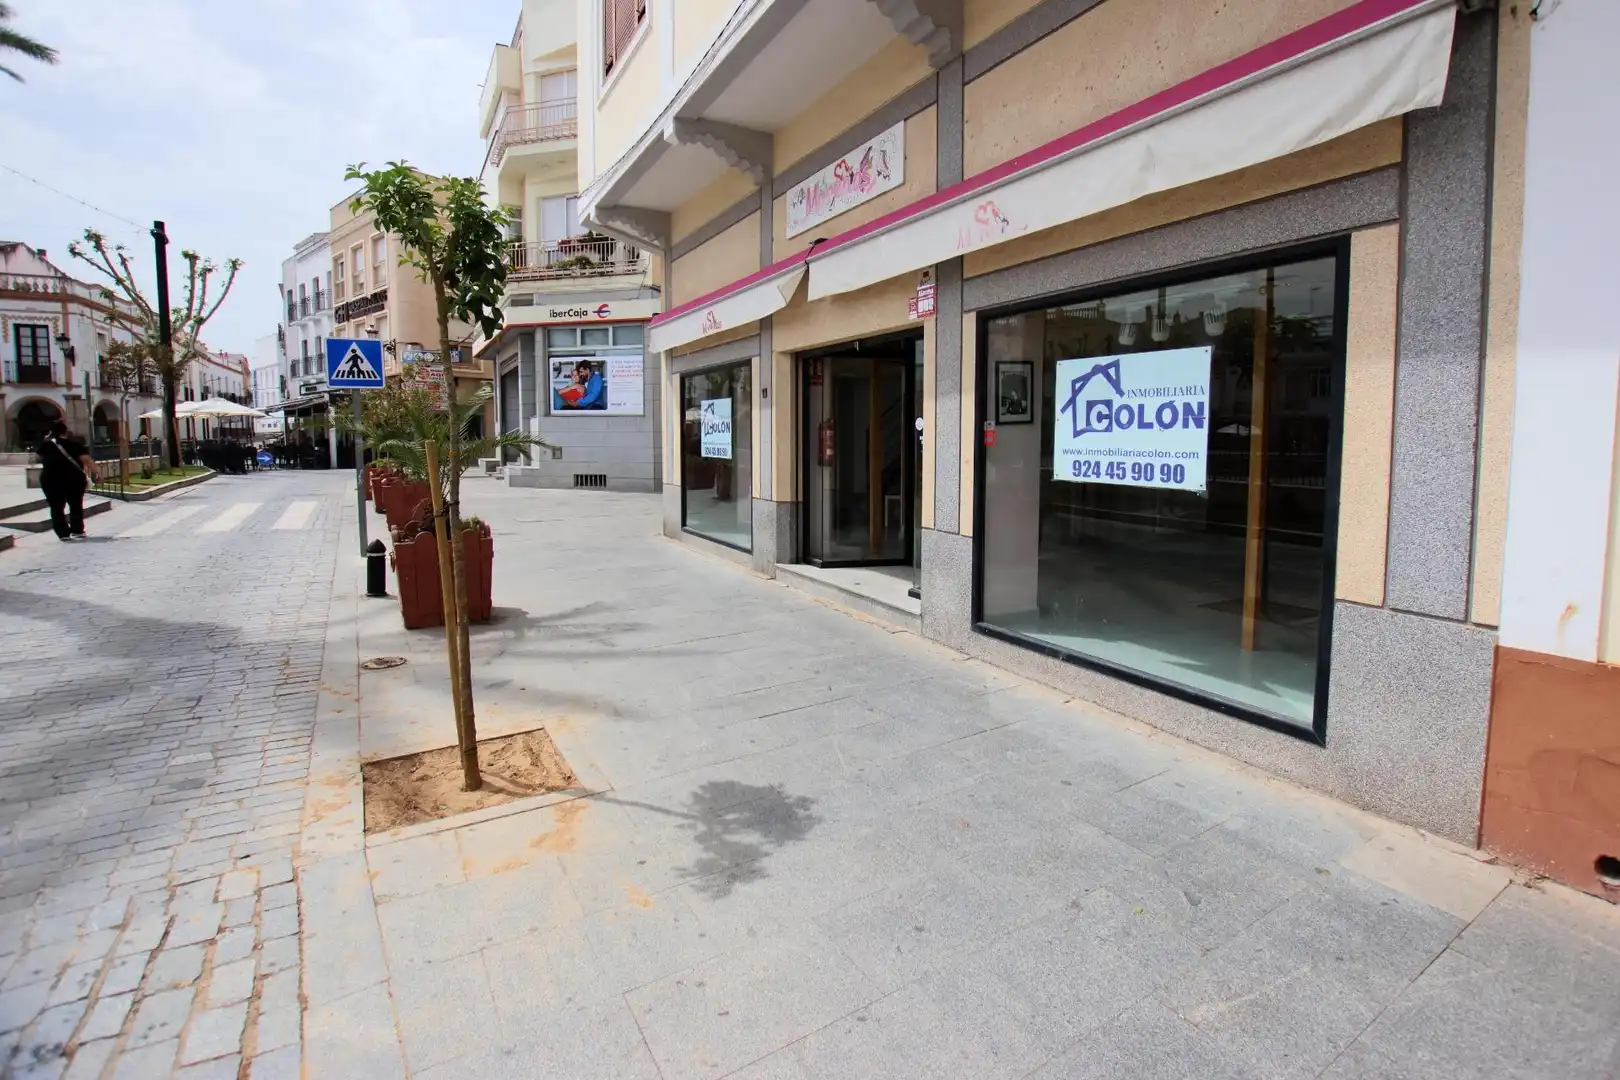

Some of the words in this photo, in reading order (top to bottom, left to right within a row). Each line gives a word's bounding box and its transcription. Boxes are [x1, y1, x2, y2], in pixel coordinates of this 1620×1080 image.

[549, 308, 588, 319] iberCaja
[1127, 385, 1206, 399] INMOBILIARIA
[1088, 400, 1205, 431] COLÓN
[1062, 447, 1199, 460] www.inmobiliariacolon.com
[1072, 459, 1101, 479] 924
[1105, 461, 1127, 481] 45
[1131, 462, 1155, 483] 90
[1159, 463, 1186, 484] 90
